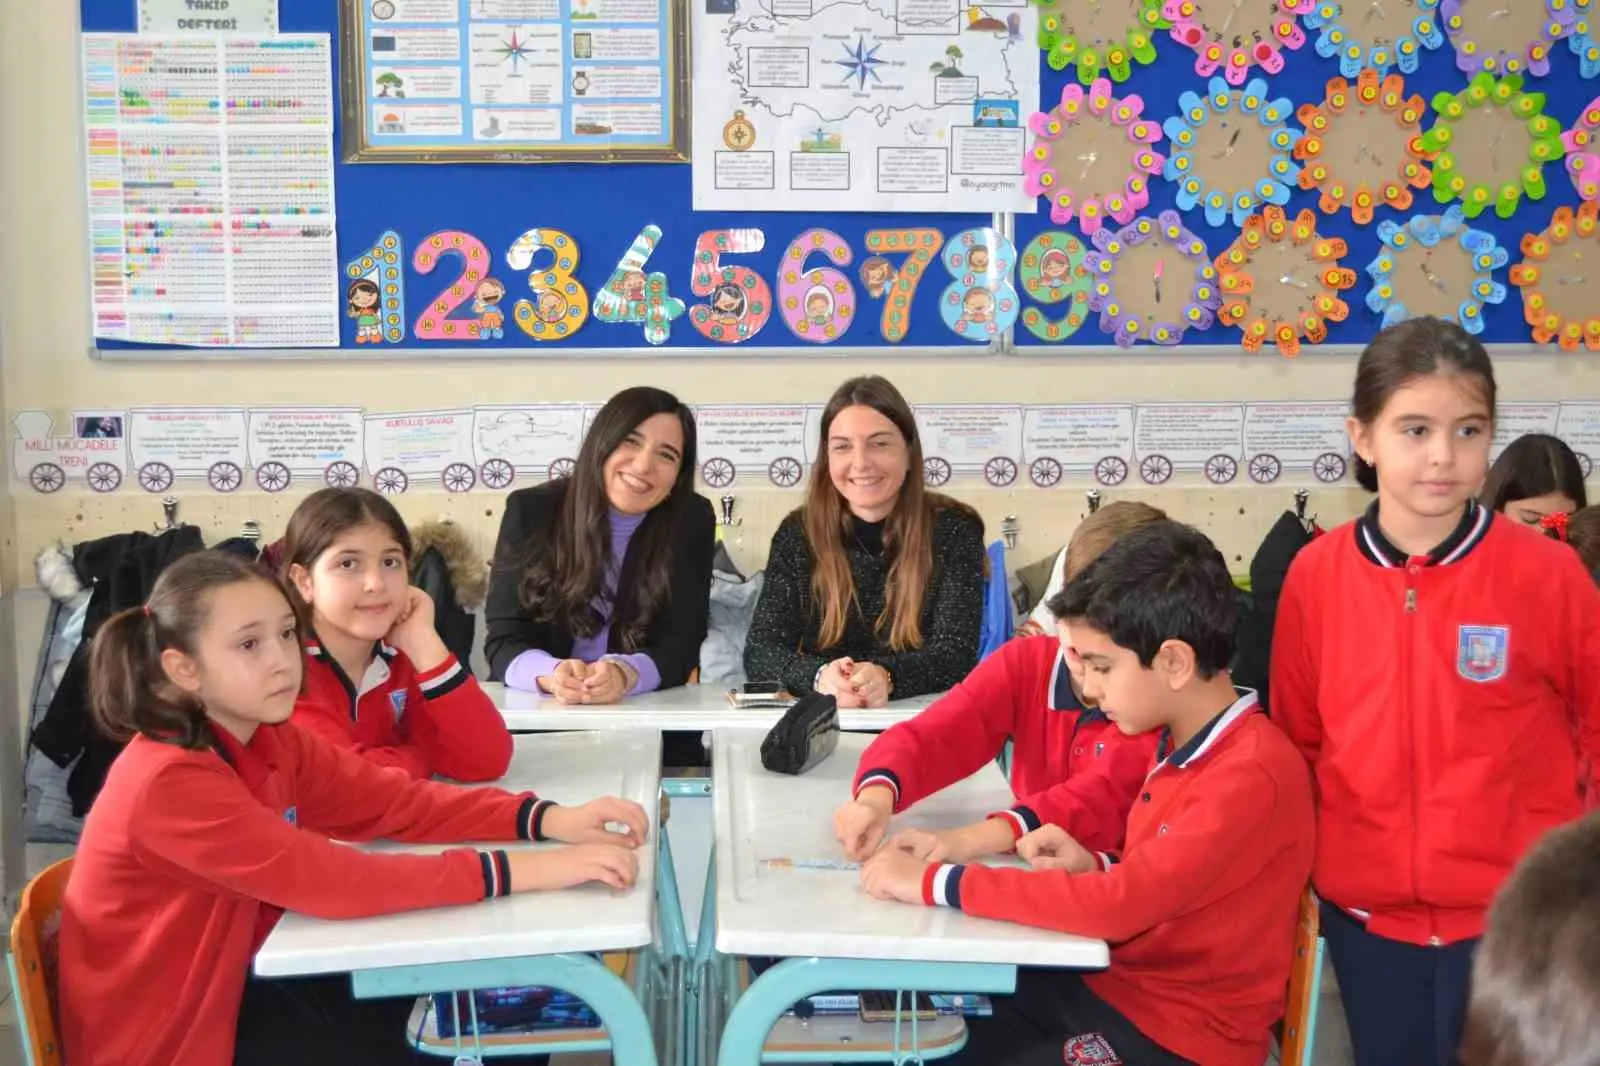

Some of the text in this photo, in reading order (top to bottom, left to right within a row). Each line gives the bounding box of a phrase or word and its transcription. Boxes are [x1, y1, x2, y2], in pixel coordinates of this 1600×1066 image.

[347, 231, 405, 343] 1
[413, 230, 490, 340] 2
[507, 228, 589, 340] 3
[593, 225, 685, 345] 4
[689, 228, 772, 343] 5
[777, 228, 856, 343] 6
[865, 228, 944, 342] 7
[939, 227, 1019, 341] 8
[1020, 231, 1092, 341] 9
